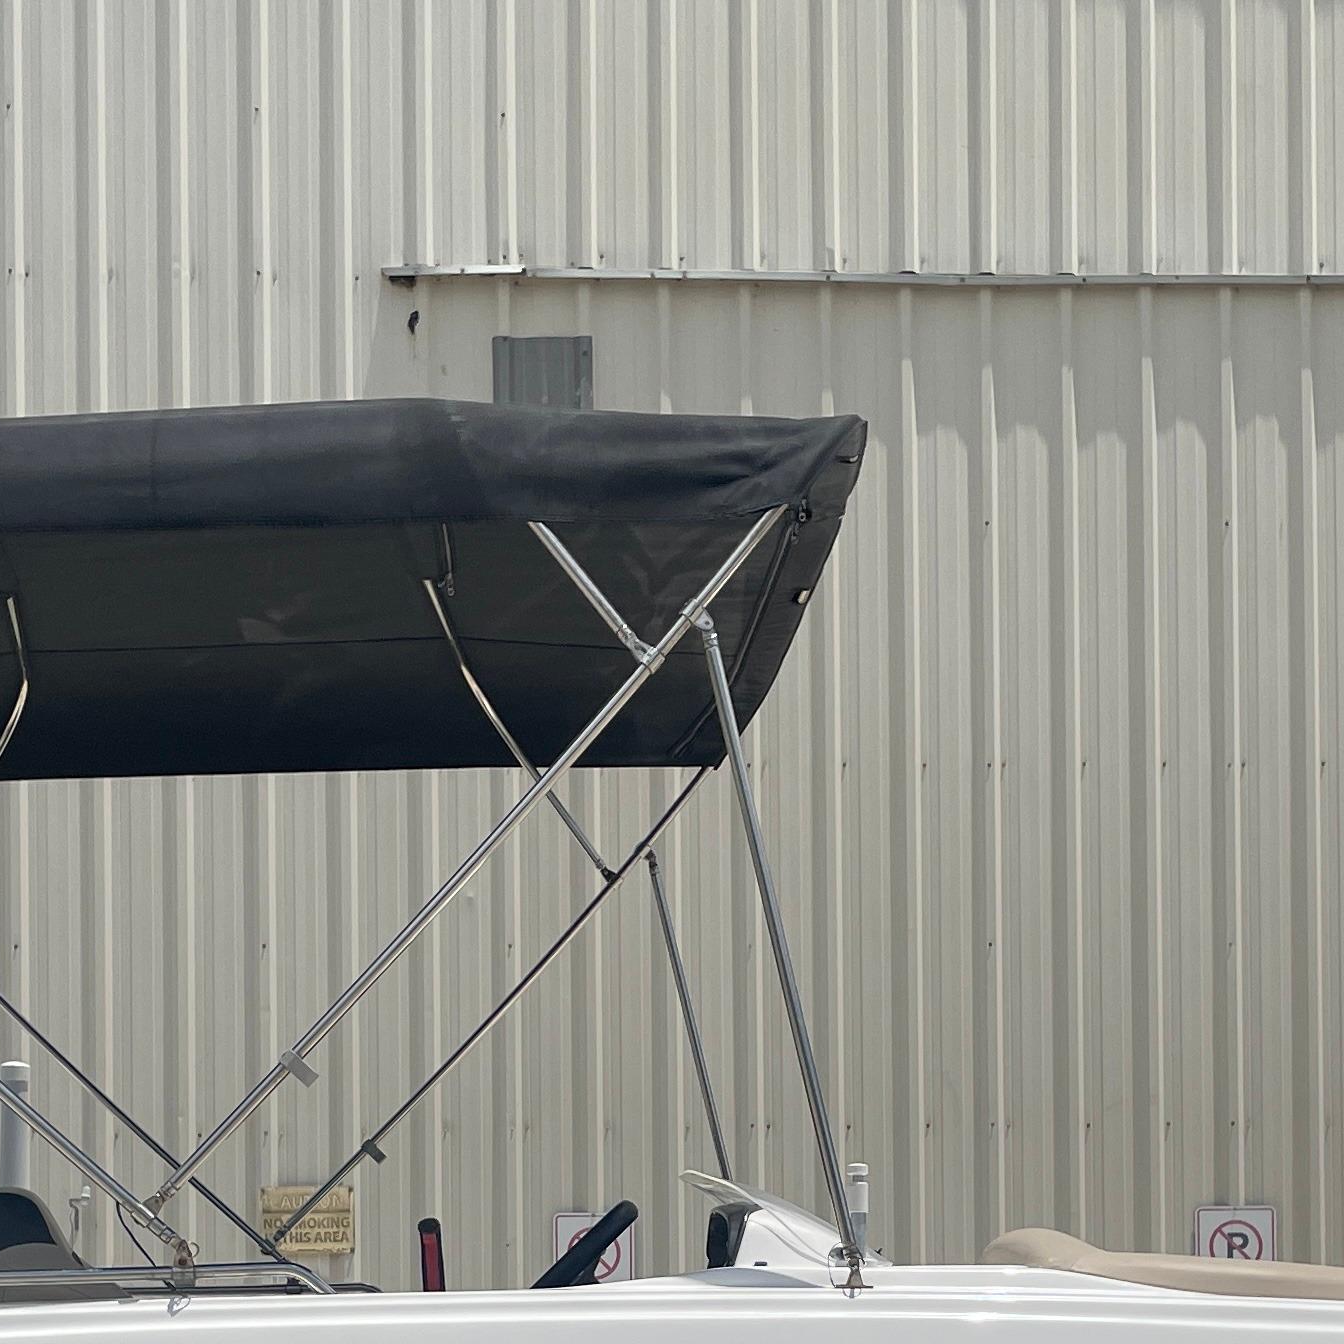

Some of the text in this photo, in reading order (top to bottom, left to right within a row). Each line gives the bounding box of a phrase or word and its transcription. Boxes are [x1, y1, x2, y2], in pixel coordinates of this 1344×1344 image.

[263, 1216, 351, 1230] NO MOKING
[314, 1231, 349, 1243] AREA
